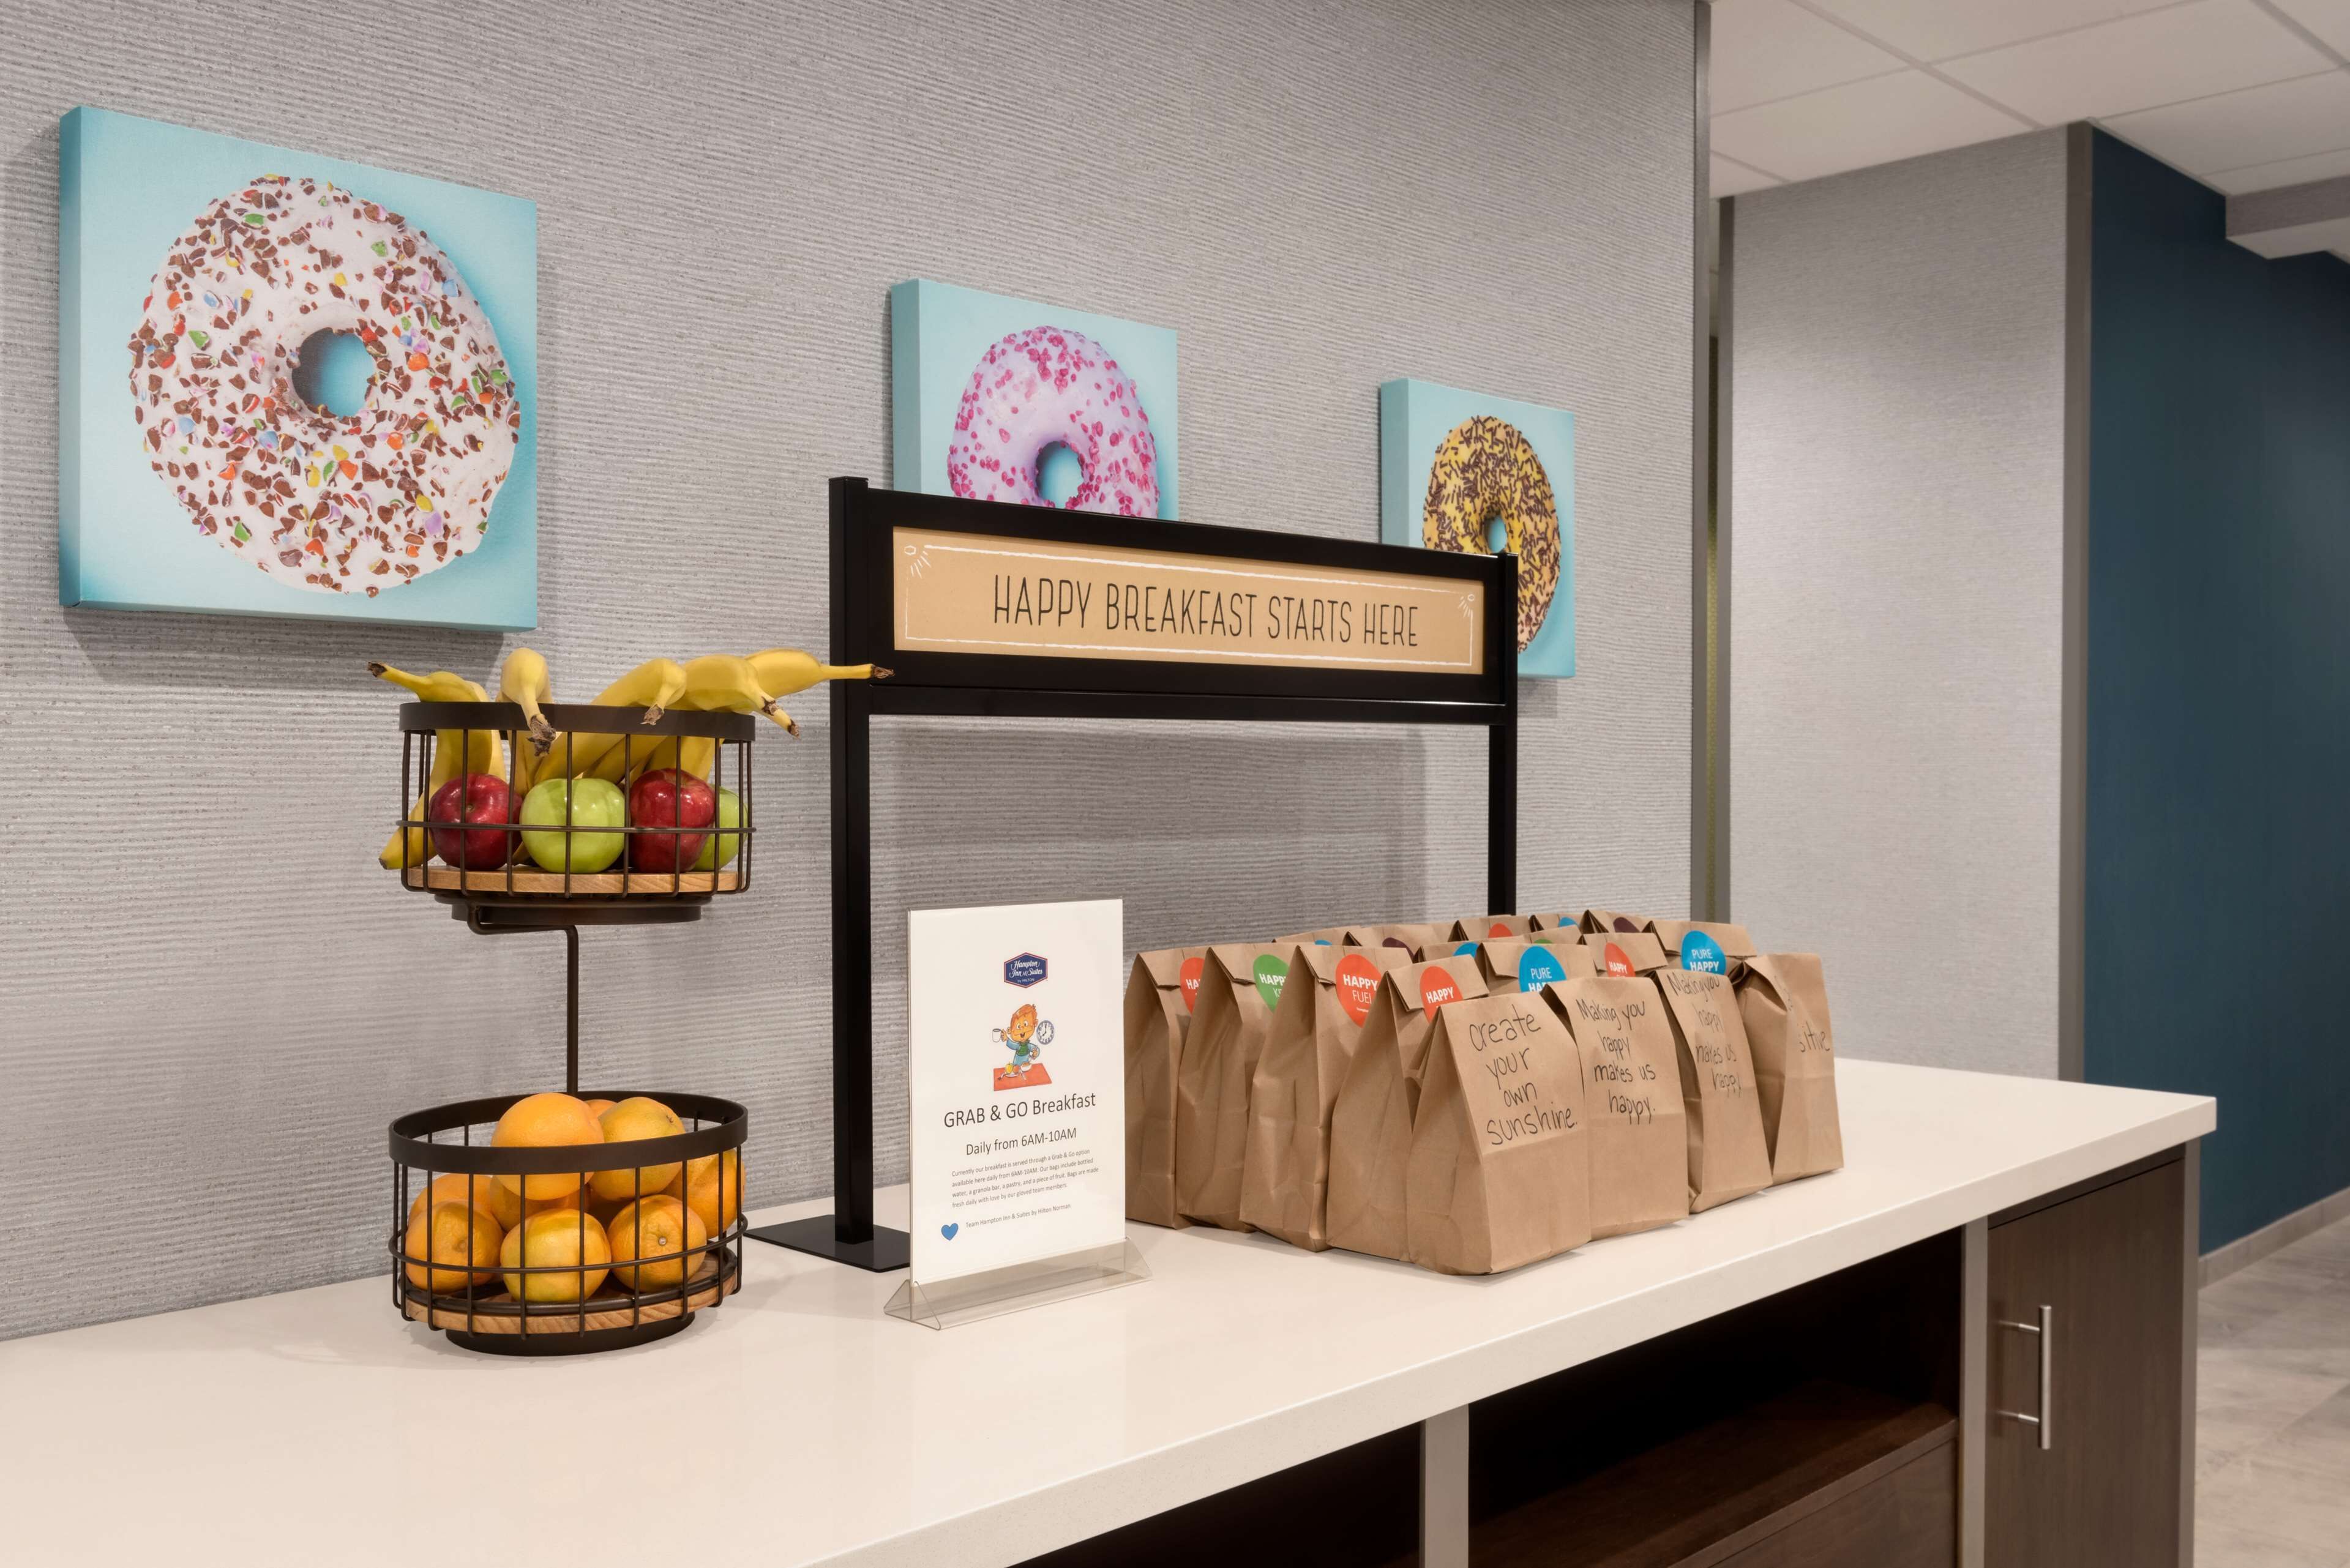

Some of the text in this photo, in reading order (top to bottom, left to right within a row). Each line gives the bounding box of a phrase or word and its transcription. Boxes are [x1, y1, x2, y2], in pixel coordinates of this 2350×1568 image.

[994, 575, 1418, 646] HAPPY BREAKFAST STARTS HERE
[1691, 949, 1712, 959] PURE
[1011, 960, 1040, 970] Hampton
[1609, 961, 1628, 974] HAPPY
[1690, 961, 1719, 972] HAPPY
[1009, 969, 1023, 978] Inn
[1027, 968, 1043, 976] Suites
[1259, 973, 1286, 986] HAPP
[1530, 967, 1552, 980] PURE
[1343, 974, 1379, 991] HAPPY
[1426, 987, 1454, 1004] HAPPY
[1576, 998, 1645, 1031] Making you
[1597, 1030, 1632, 1062] happy
[1486, 1047, 1529, 1090] your
[1594, 1060, 1656, 1083] makes us
[1503, 1082, 1537, 1107] own
[944, 1092, 1096, 1127] GRAB & GO Breakfast
[966, 1127, 1077, 1155] Daily from 6AM-10AM
[1028, 1155, 1047, 1163] through
[952, 1179, 973, 1187] available
[973, 1186, 991, 1195] granola
[1006, 1181, 1022, 1190] pastry,
[1016, 1188, 1032, 1197] gloved
[980, 1216, 1002, 1225] Hampton
